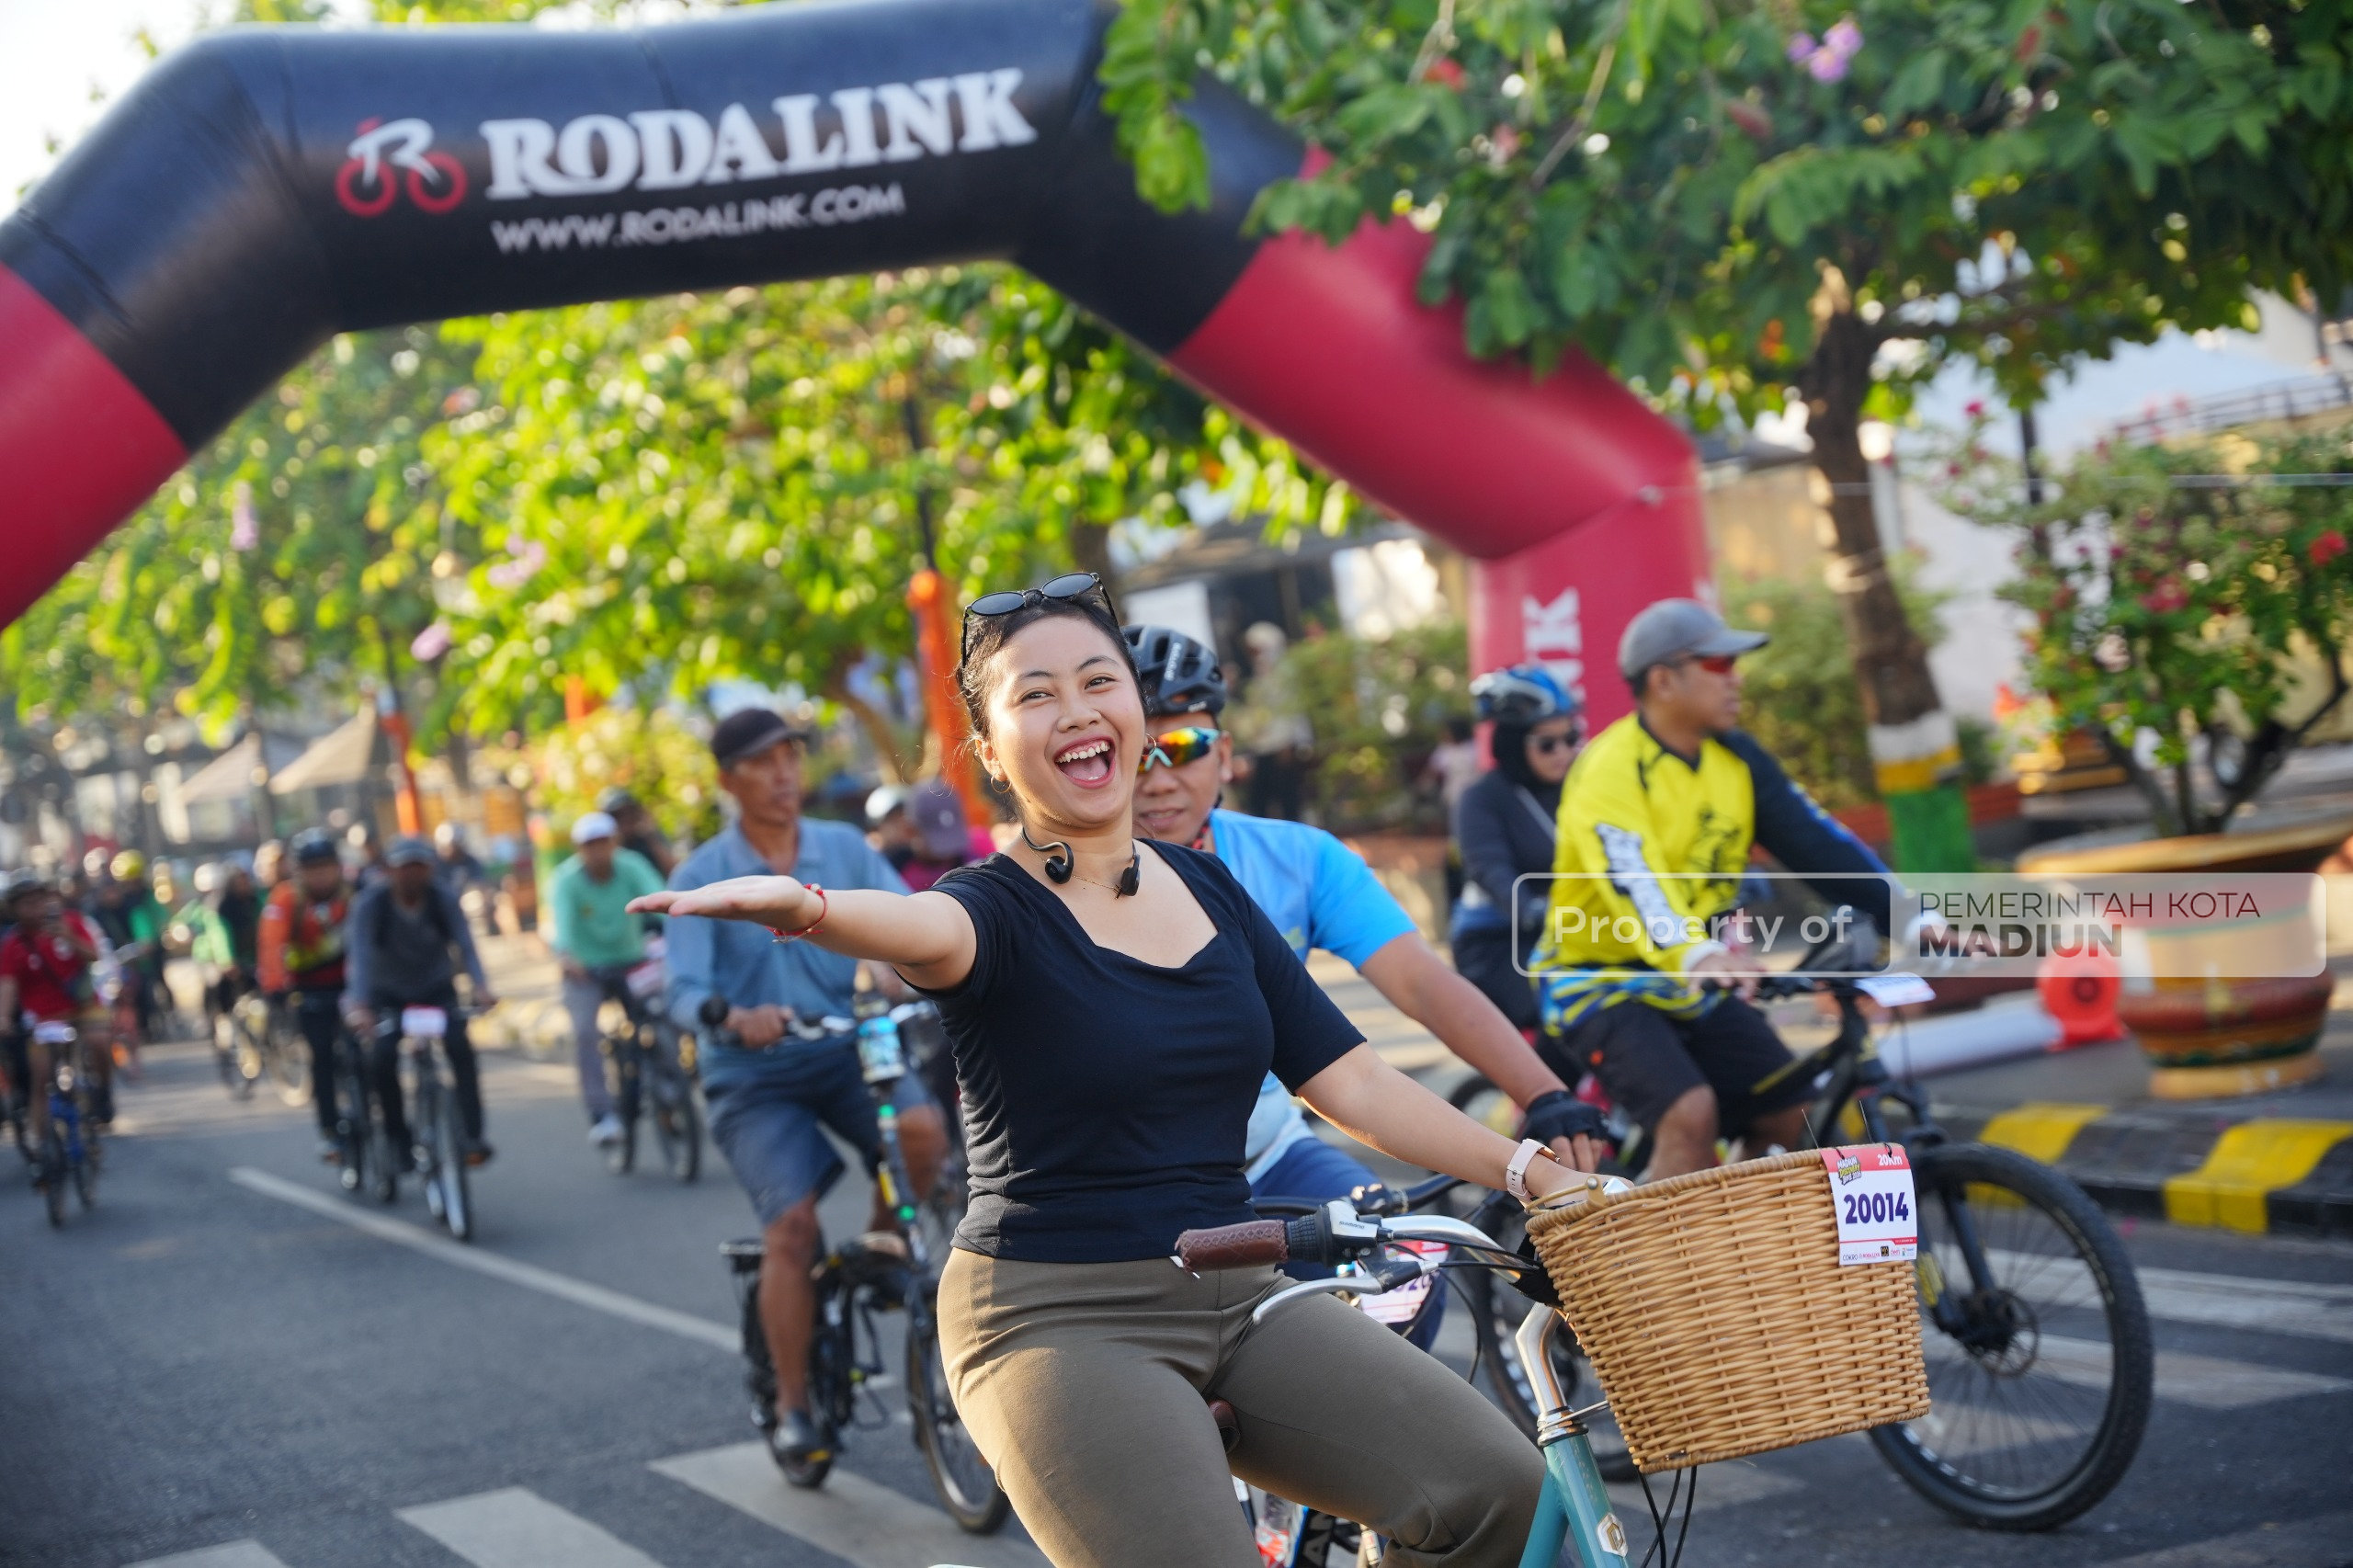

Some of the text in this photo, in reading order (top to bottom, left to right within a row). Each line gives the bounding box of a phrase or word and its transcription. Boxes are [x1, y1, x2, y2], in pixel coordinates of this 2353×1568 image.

[478, 68, 1039, 199] RODALINK
[491, 185, 906, 256] WWW.RODALINK.COM
[1844, 1192, 1908, 1224] 20014
